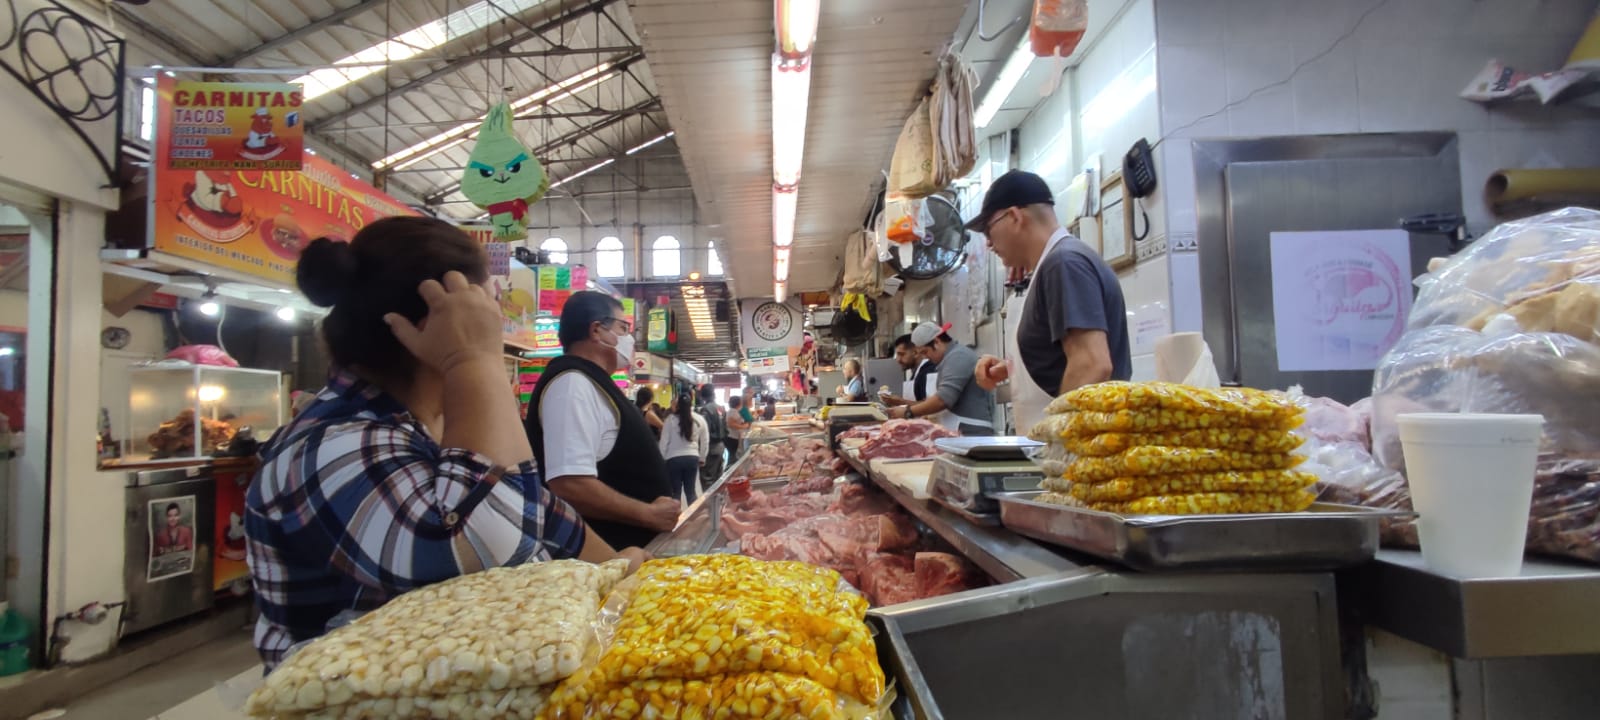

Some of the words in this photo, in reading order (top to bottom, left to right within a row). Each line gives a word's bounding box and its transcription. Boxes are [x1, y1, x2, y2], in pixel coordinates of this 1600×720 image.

[174, 90, 303, 108] CARNITAS
[175, 109, 225, 123] TACOS
[237, 170, 365, 230] CARNITAS
